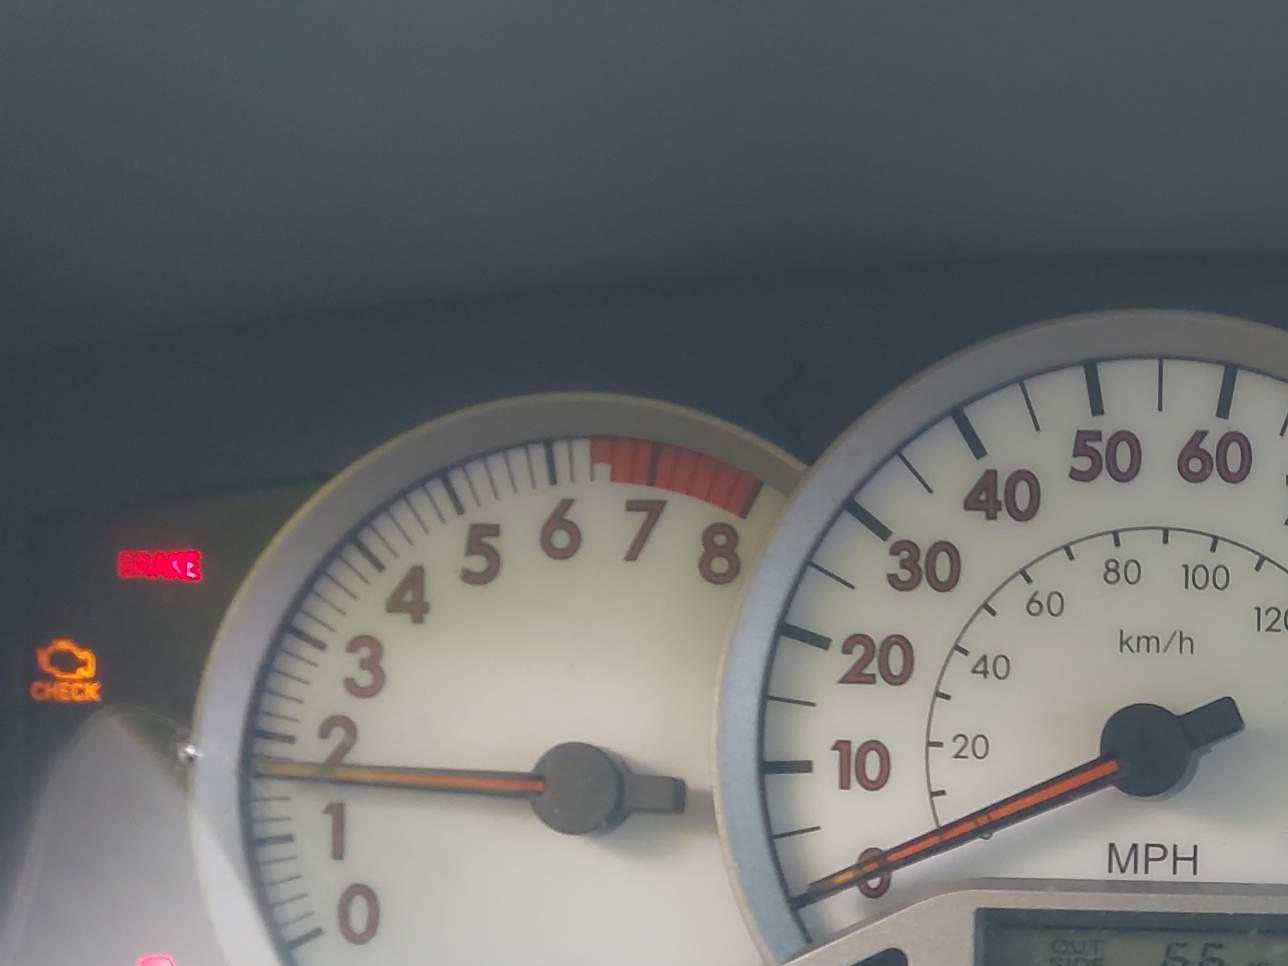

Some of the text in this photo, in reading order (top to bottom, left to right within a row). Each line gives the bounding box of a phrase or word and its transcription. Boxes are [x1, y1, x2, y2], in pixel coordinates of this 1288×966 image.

[1069, 430, 1141, 482] 50
[1177, 431, 1252, 483] 60
[963, 469, 1041, 522] 40
[460, 524, 501, 586] 5
[540, 498, 582, 561] 6
[625, 500, 667, 562] 7
[699, 523, 741, 585] 8
[887, 540, 962, 592] 30
[1103, 559, 1142, 585] 80
[1182, 565, 1230, 593] 100
[386, 566, 430, 624] 4
[1026, 591, 1065, 618] 60
[345, 635, 386, 698] 3
[839, 634, 914, 686] 20
[971, 655, 1011, 681] 40
[1118, 630, 1195, 657] km/h
[31, 680, 101, 702] CHECK
[831, 741, 891, 791] 10
[954, 735, 990, 760] 20
[322, 803, 345, 859] 1
[1108, 843, 1198, 876] MPH
[338, 884, 379, 944] 0
